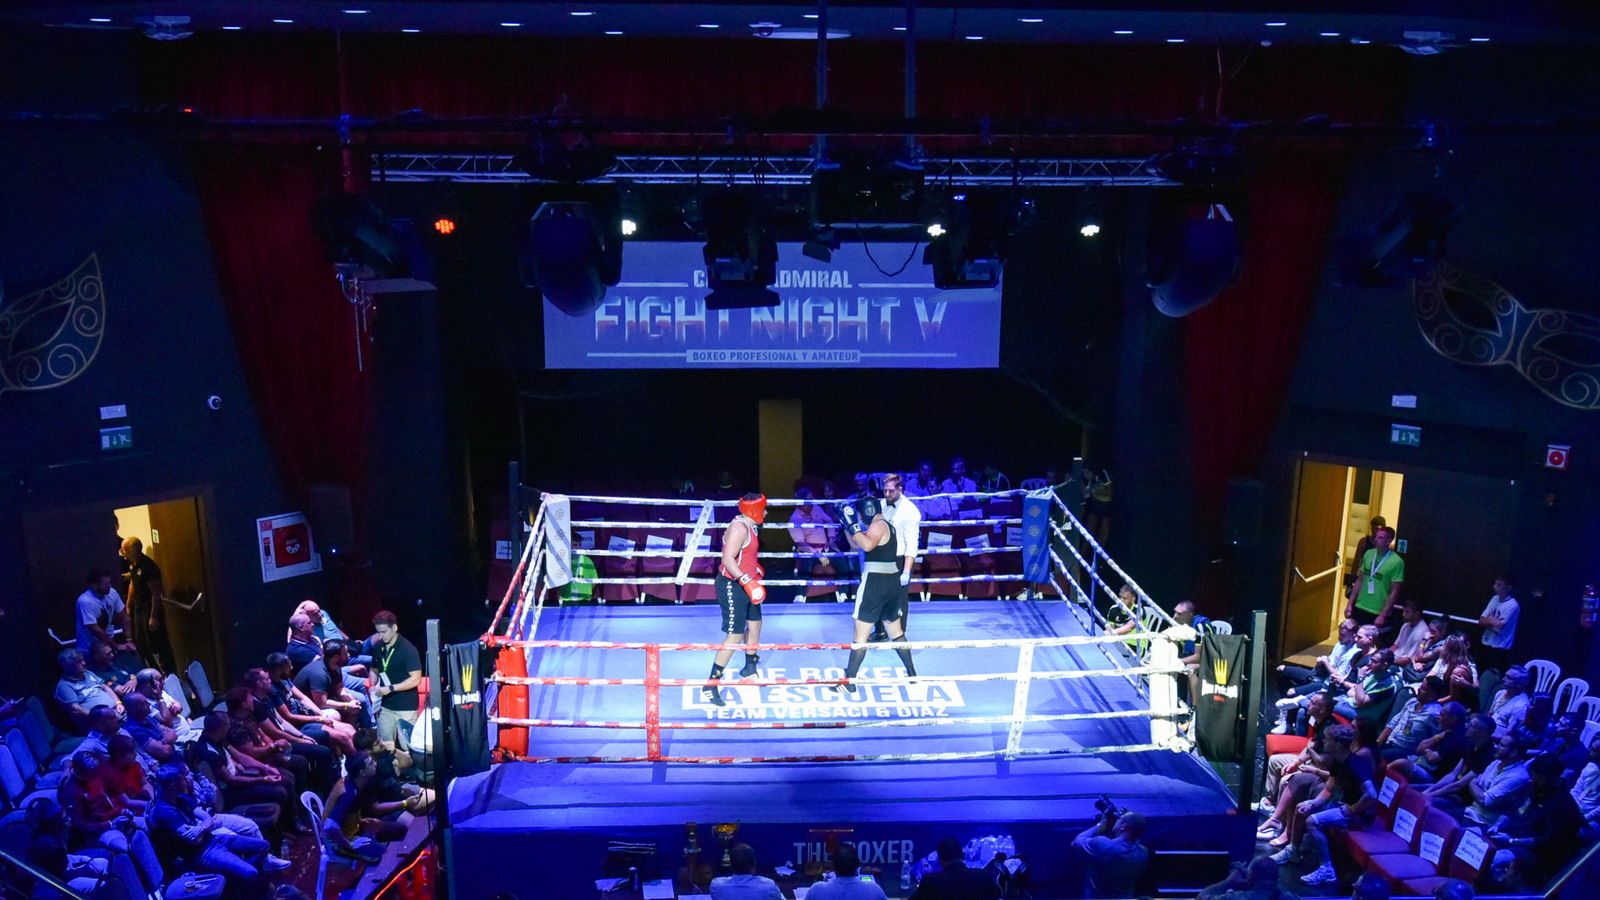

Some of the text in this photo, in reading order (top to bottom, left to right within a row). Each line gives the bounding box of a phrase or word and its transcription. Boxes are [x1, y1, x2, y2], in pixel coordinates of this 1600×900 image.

[751, 296, 900, 342] NIGHT
[913, 296, 948, 341] V
[692, 351, 859, 361] BOXEO PROFESIONAL Y AMATEUR
[692, 685, 953, 704] LA ESCUELA
[703, 706, 949, 719] TEAM VERSACI & DIAZ
